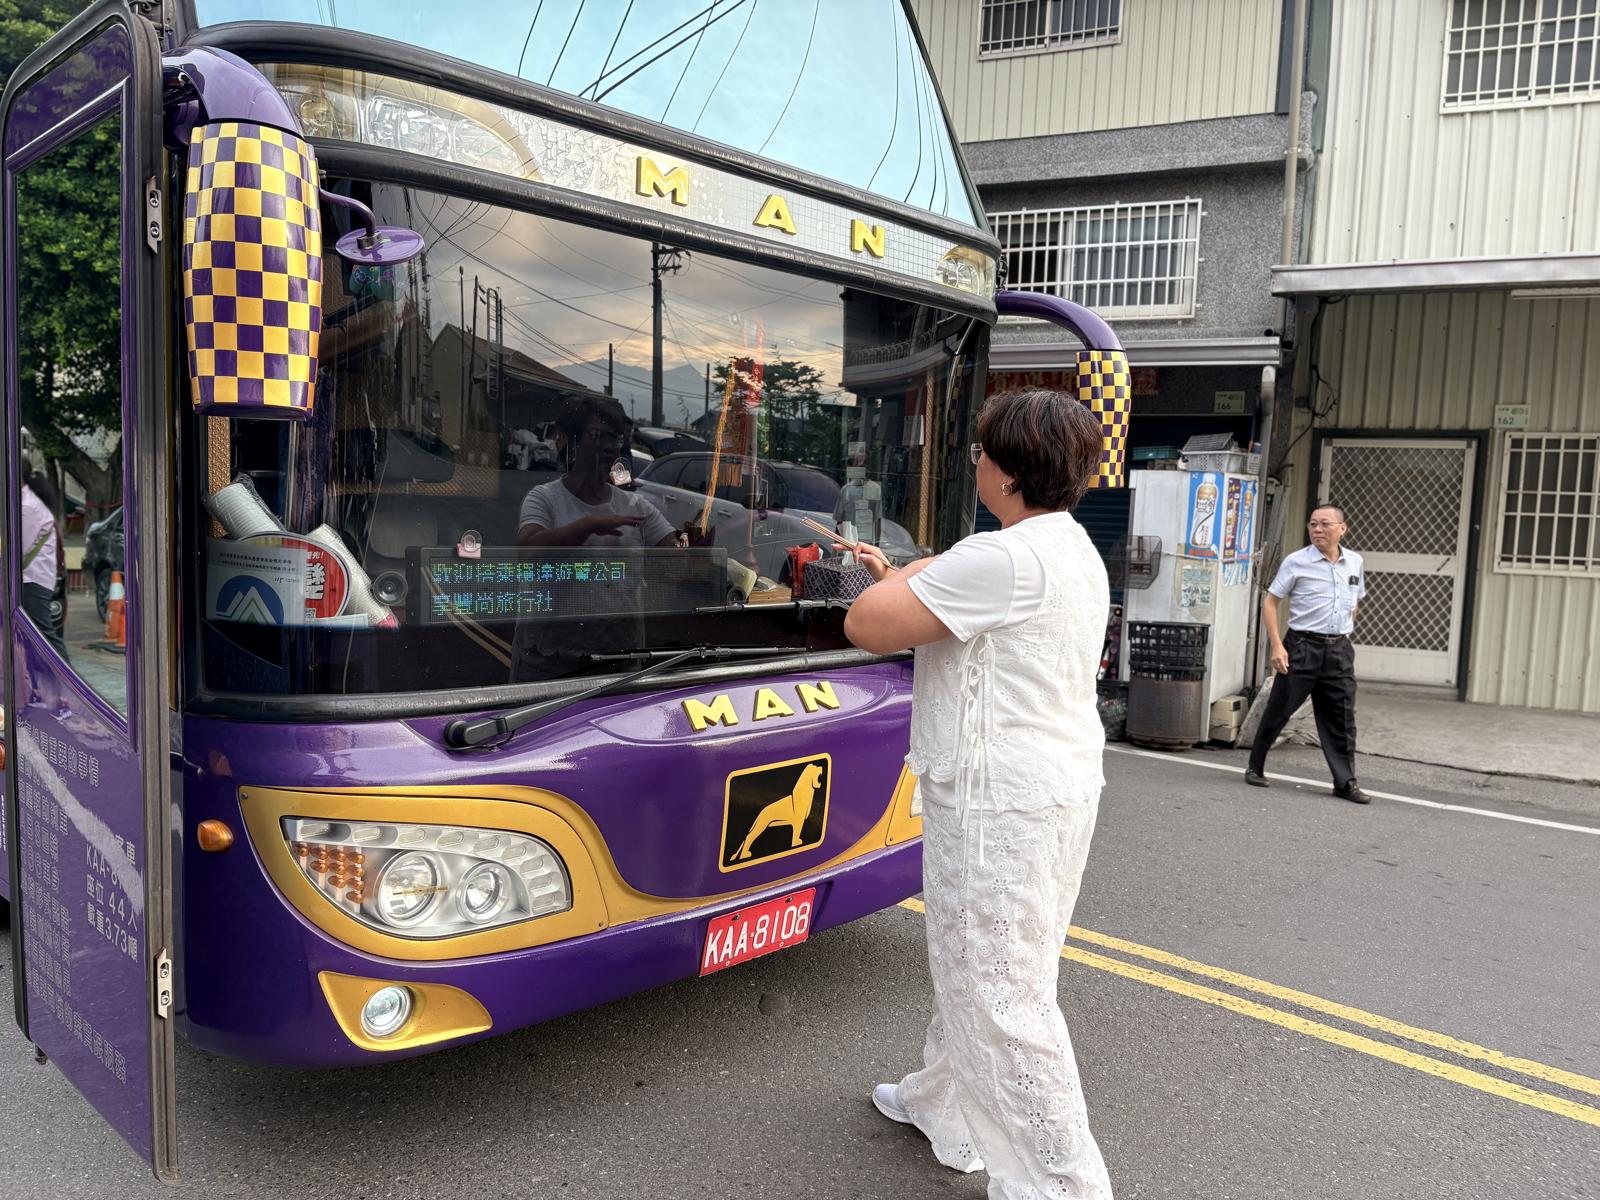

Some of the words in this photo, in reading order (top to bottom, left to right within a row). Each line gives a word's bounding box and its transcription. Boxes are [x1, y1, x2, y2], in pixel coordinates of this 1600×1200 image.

[636, 155, 887, 258] MAN
[1498, 416, 1515, 425] 162
[683, 680, 840, 732] MAN
[86, 874, 104, 905] 座位
[108, 892, 125, 920] 44
[127, 906, 138, 932] 人
